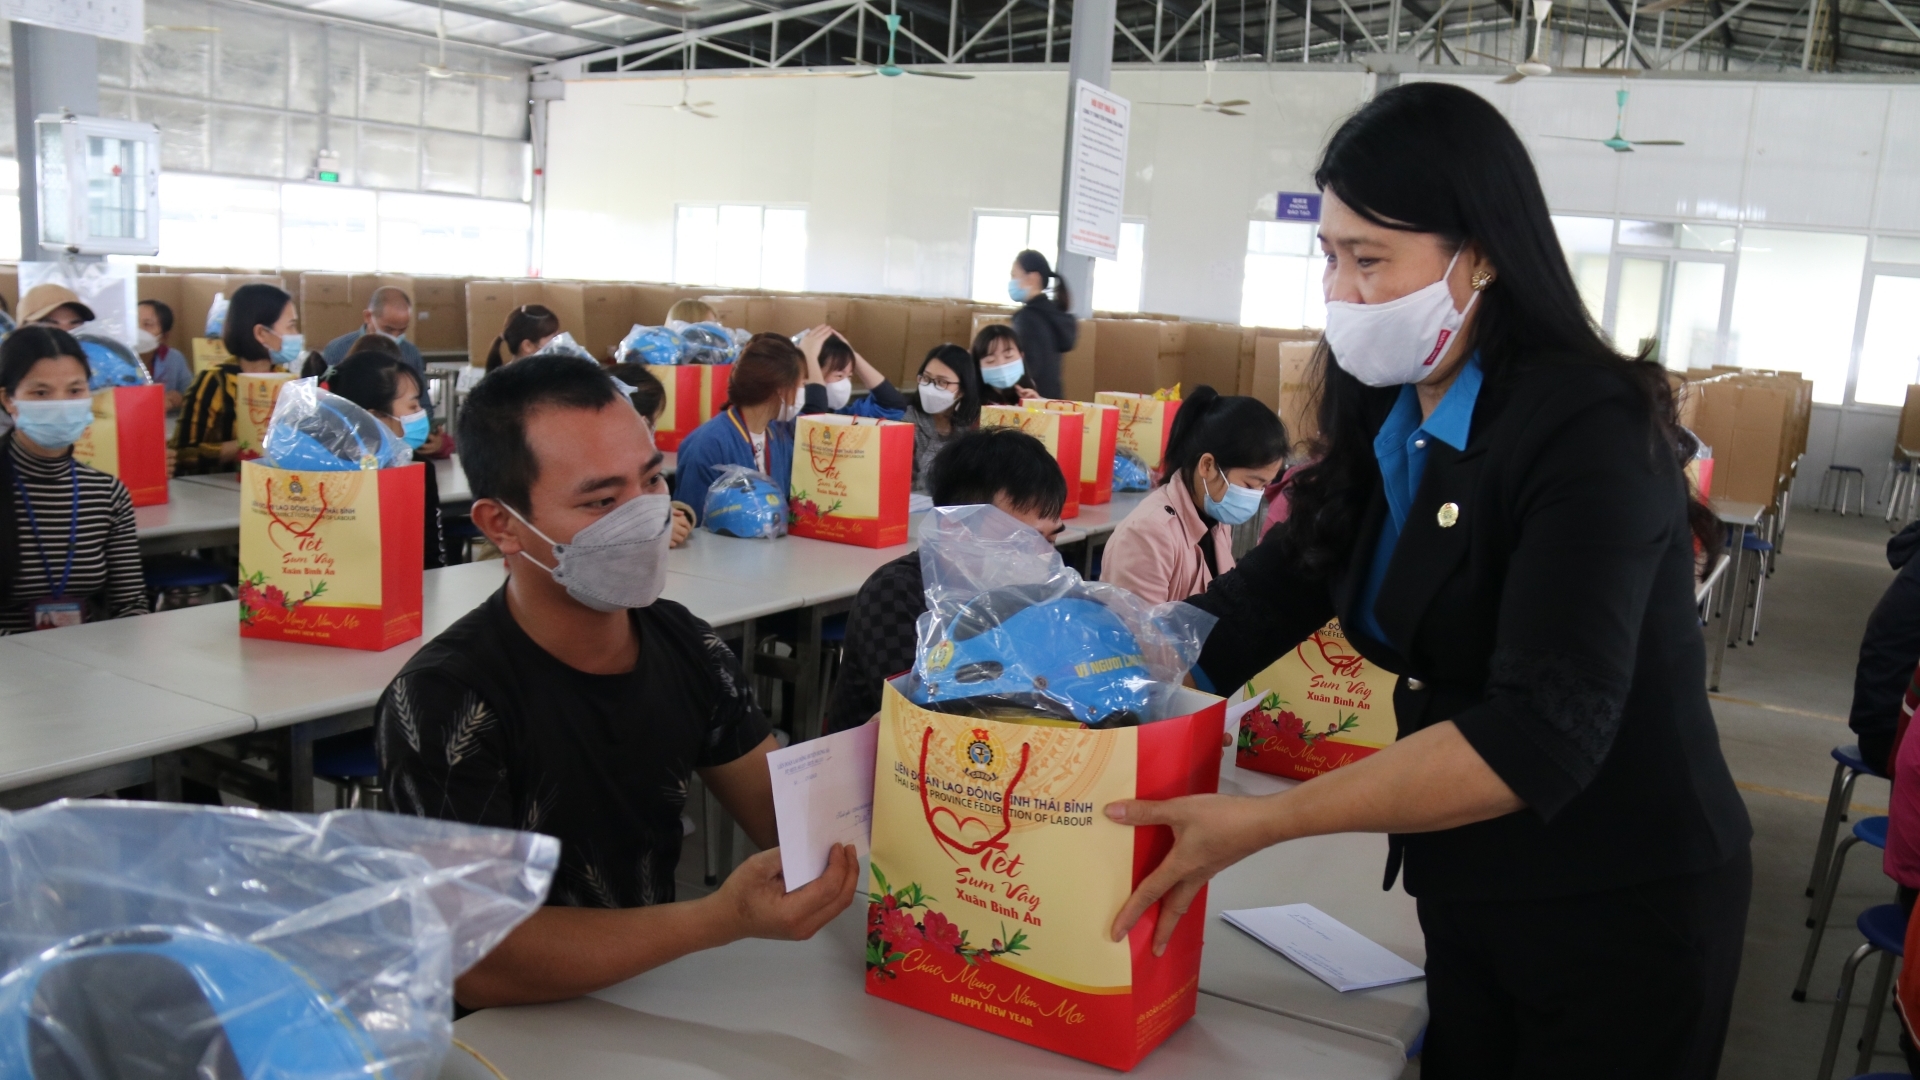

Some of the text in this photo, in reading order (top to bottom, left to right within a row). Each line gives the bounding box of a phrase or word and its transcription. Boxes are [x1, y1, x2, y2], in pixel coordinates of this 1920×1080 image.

[1306, 690, 1331, 704] Xuân
[1357, 700, 1371, 710] An
[1309, 674, 1341, 691] Sum
[894, 761, 909, 777] LIÊN
[911, 770, 940, 788] ĐÀN
[942, 780, 964, 794] LAO
[1034, 797, 1060, 812] THÁI
[1064, 799, 1093, 813] BÌNH
[894, 773, 909, 788] THAI
[929, 789, 972, 809] PROVINCE
[974, 800, 1032, 821] FEDERTION
[1034, 812, 1048, 823] OF
[1050, 814, 1093, 827] LABOUR
[955, 867, 997, 893] Sum
[955, 887, 987, 909] Xuân
[1023, 911, 1042, 927] An
[950, 993, 1034, 1028] HAPPY NEW YEAR
